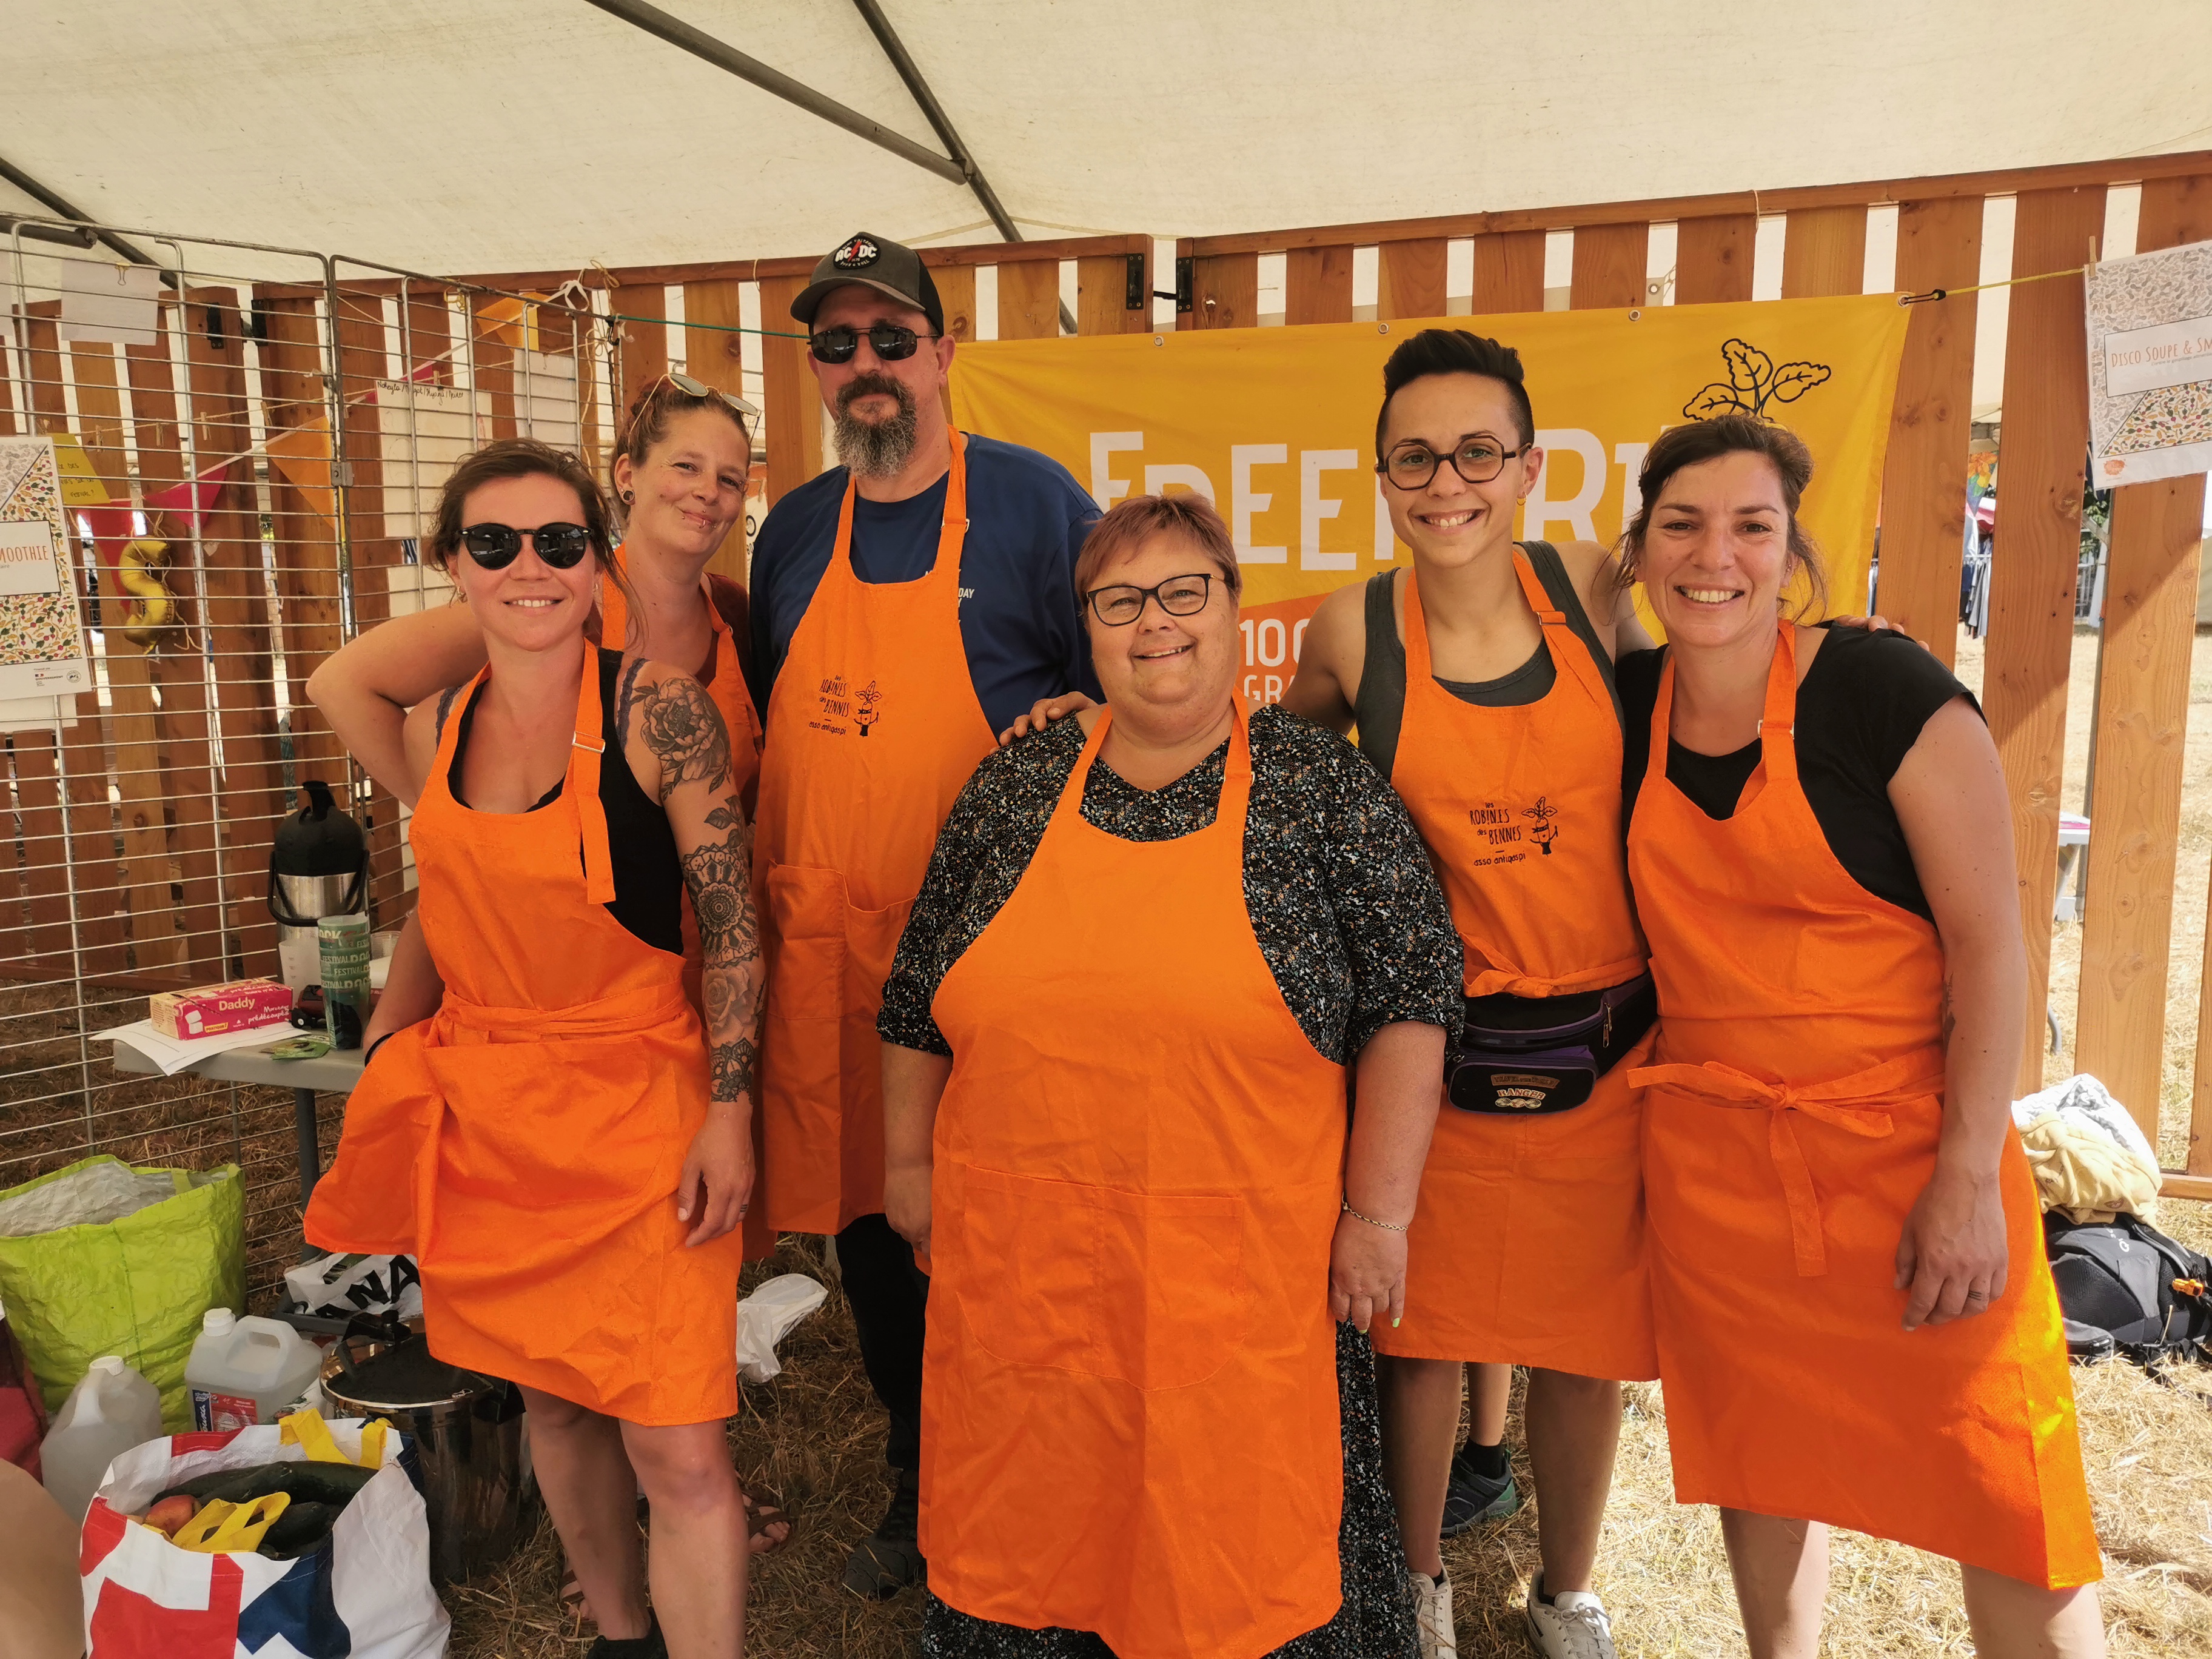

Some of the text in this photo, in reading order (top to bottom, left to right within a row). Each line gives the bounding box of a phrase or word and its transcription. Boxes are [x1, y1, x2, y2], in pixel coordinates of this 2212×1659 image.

[2111, 350, 2141, 367] DISCO
[2146, 344, 2178, 362] SOUPE
[2184, 340, 2193, 355] &
[809, 720, 846, 736] asso antigaspi
[1489, 825, 1521, 845] BENNES
[1473, 851, 1526, 866] asso antigaspi
[219, 996, 255, 1011] Daddy
[1496, 1088, 1546, 1100] RANGER
